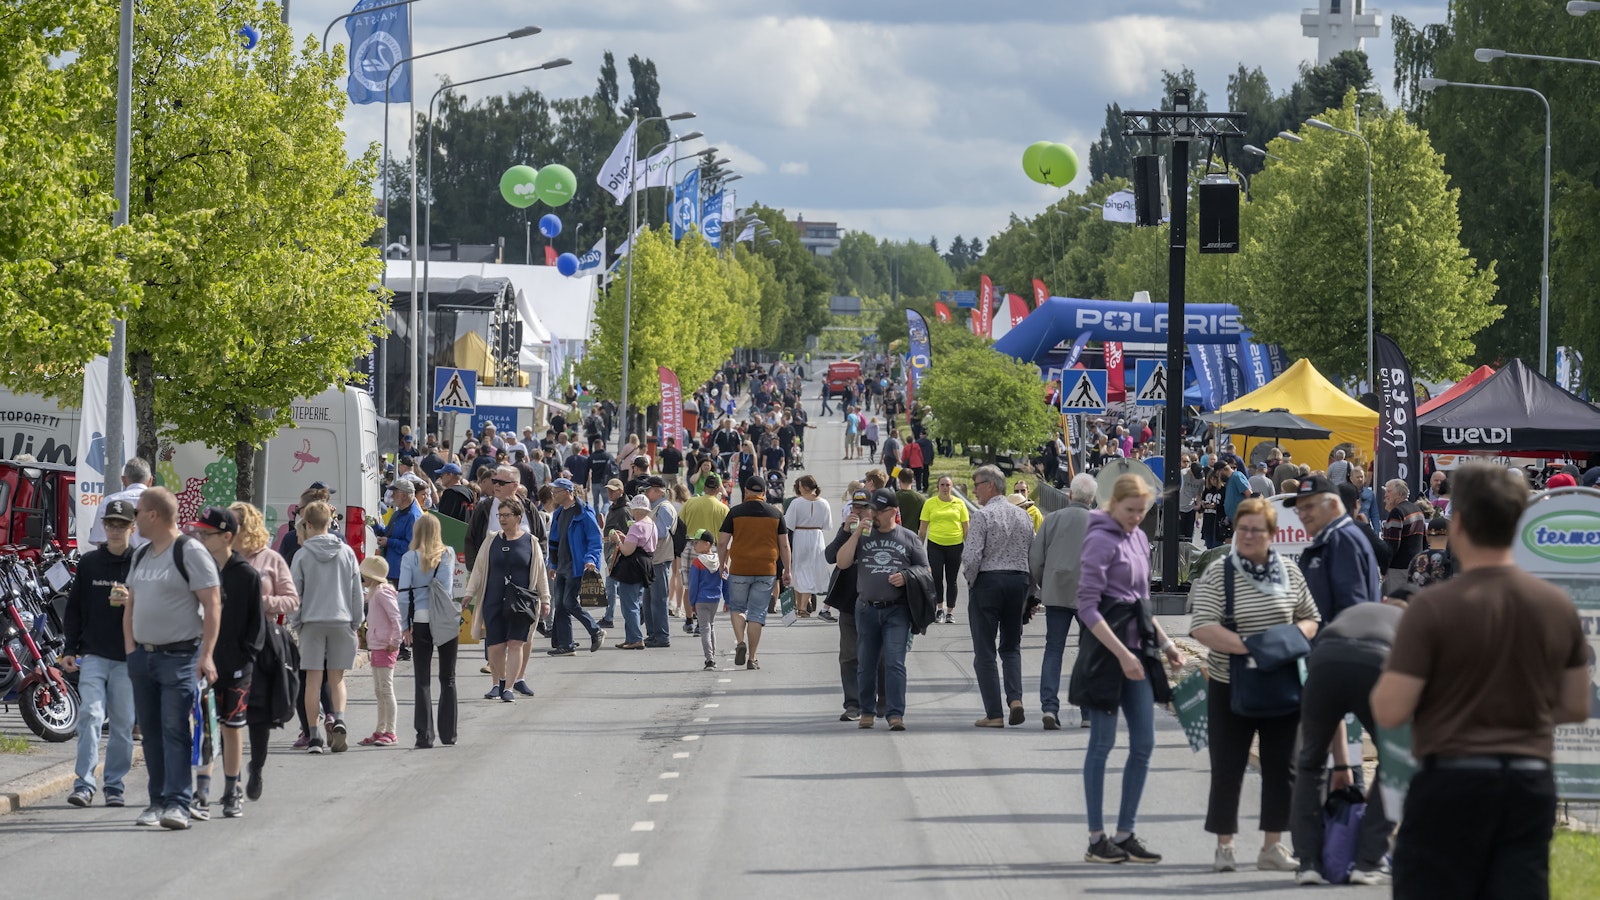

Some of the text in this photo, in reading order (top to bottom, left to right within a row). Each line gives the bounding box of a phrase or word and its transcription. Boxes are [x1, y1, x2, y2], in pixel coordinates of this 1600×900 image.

[1202, 241, 1237, 250] BOSE
[1075, 308, 1244, 335] POLARIS
[478, 422, 510, 430] OSTA
